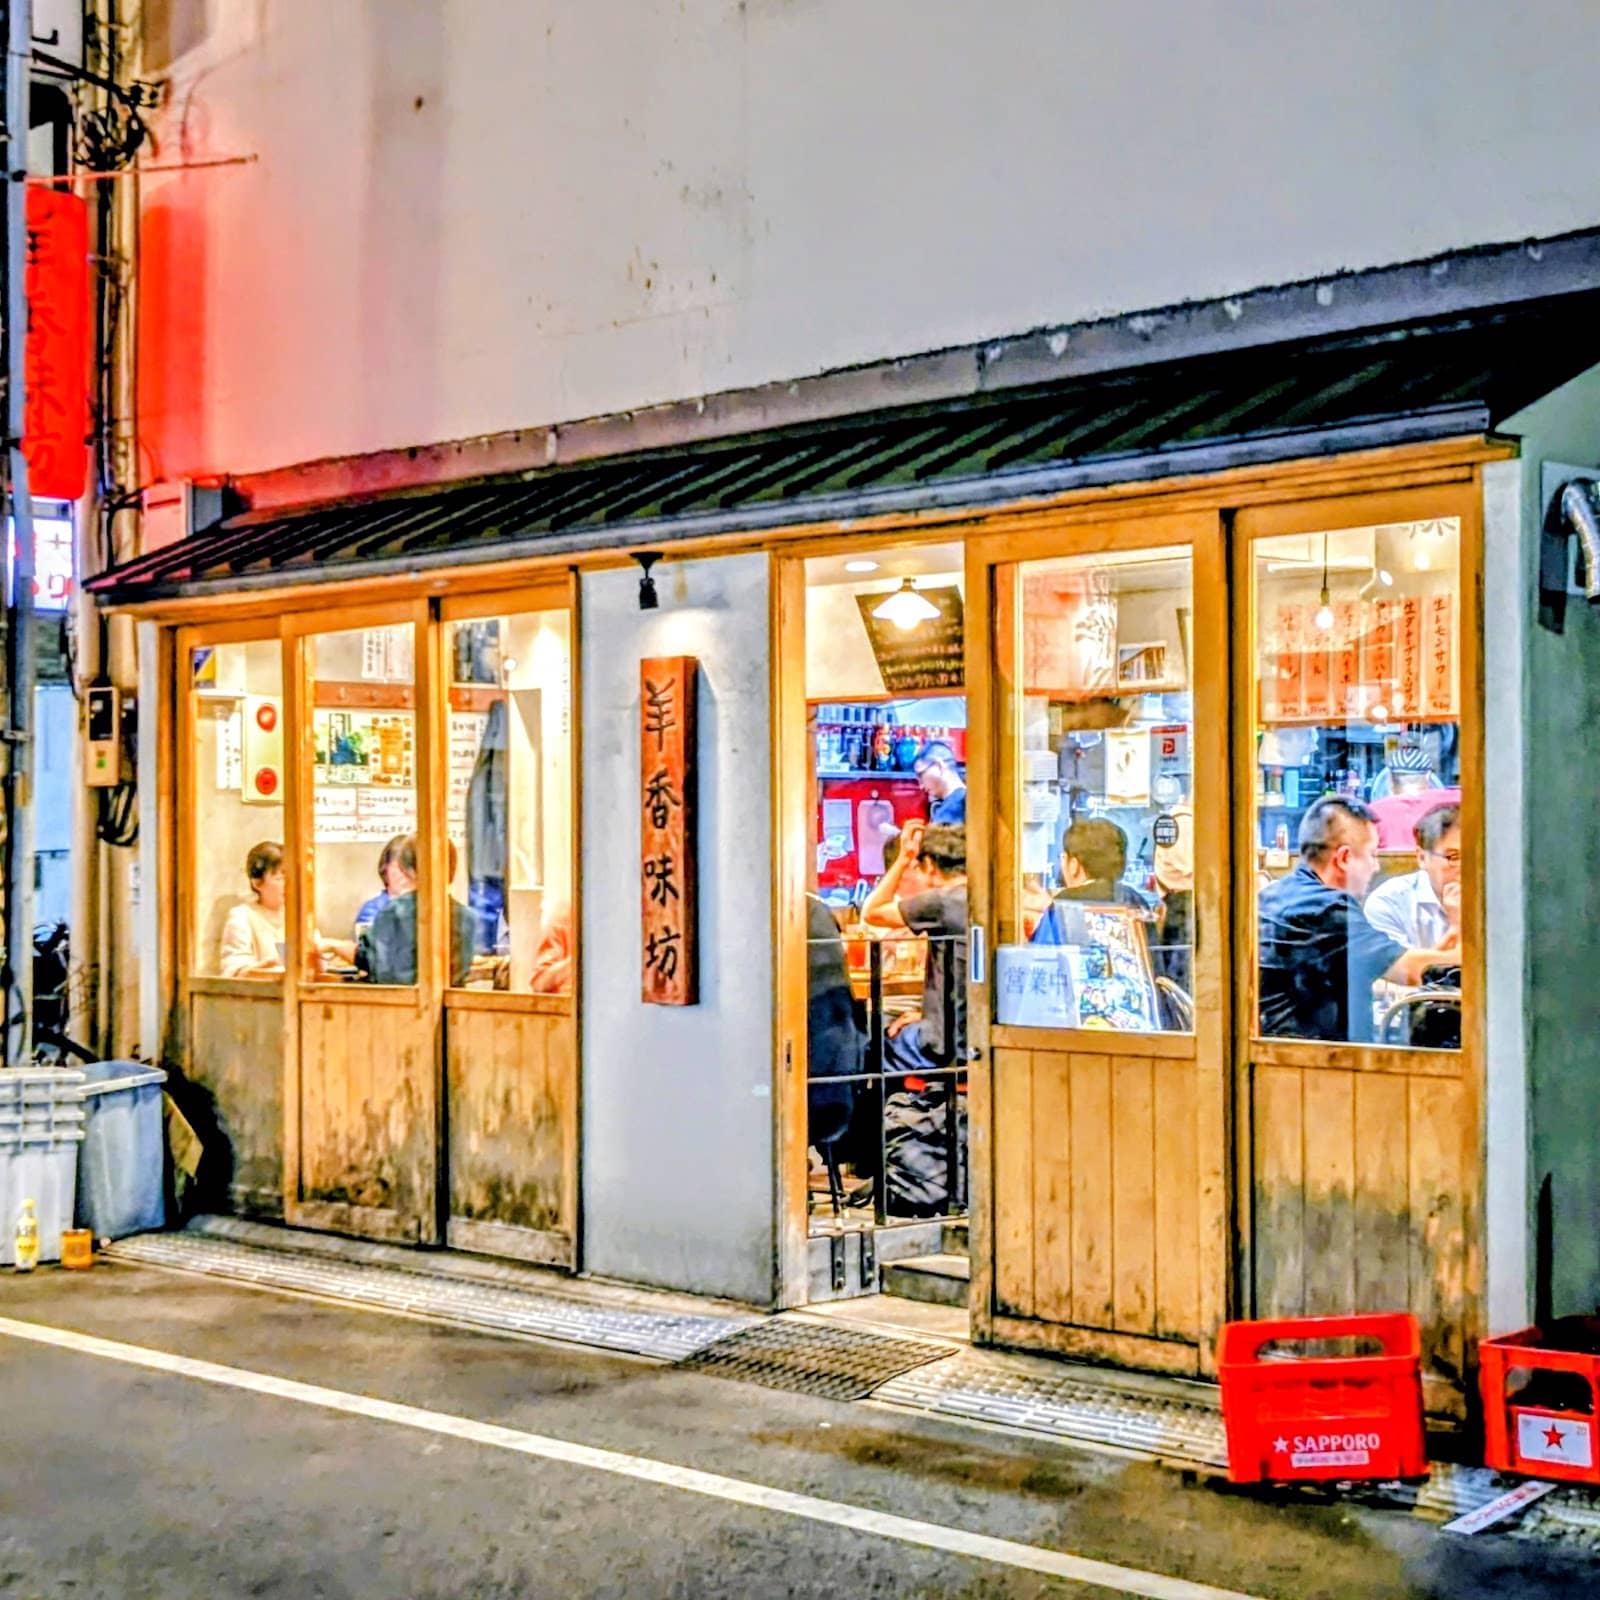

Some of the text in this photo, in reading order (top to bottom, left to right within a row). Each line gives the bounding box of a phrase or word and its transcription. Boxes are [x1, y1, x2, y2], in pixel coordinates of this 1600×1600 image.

[644, 677, 681, 980] 羊香味坊
[1003, 966, 1068, 996] 営業中
[1293, 1433, 1380, 1453] SAPPORO
